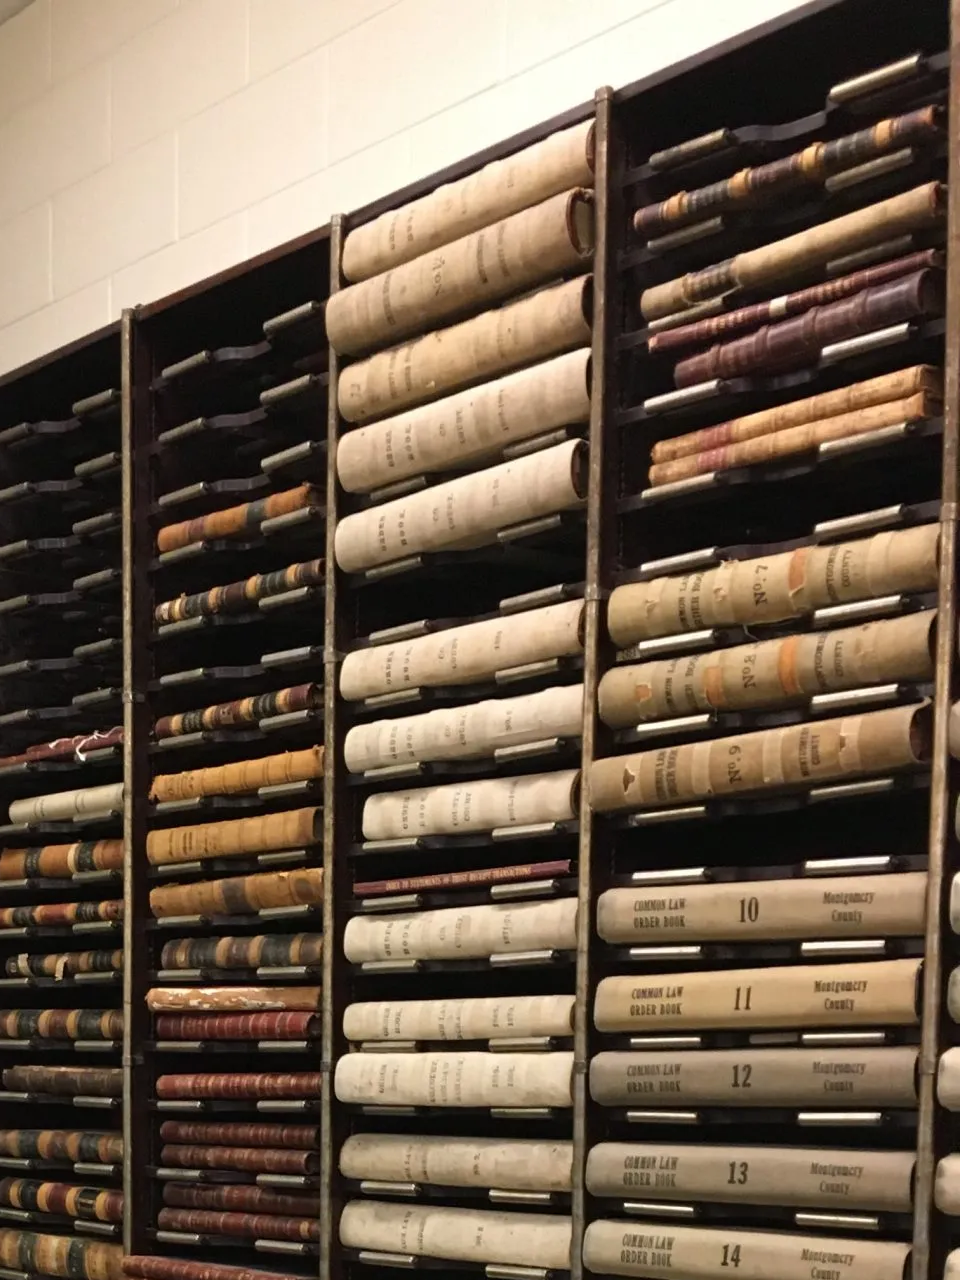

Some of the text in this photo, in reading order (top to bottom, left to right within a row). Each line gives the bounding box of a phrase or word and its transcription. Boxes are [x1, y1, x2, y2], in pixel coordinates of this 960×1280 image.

[842, 550, 852, 588] COUNTY
[835, 640, 844, 677] COUNTY
[812, 734, 820, 765] COUNTY
[634, 898, 686, 912] COMMON LAW
[739, 897, 759, 923] 10
[634, 915, 685, 928] ORDER BOOK
[631, 986, 683, 1000] COMMON LAW
[733, 986, 752, 1010] 11
[630, 1002, 682, 1015] ORDER BOOK
[628, 1063, 681, 1076] COMMON LAW
[731, 1064, 752, 1088] 12
[627, 1080, 681, 1093] ORDER BOOK
[624, 1156, 678, 1171] COMMON LAW
[623, 1173, 677, 1187] ORDER BOOK
[727, 1161, 749, 1185] 13
[622, 1234, 675, 1251] COMMON LAW
[621, 1251, 673, 1267] ORDER BOOK
[721, 1245, 741, 1267] 14
